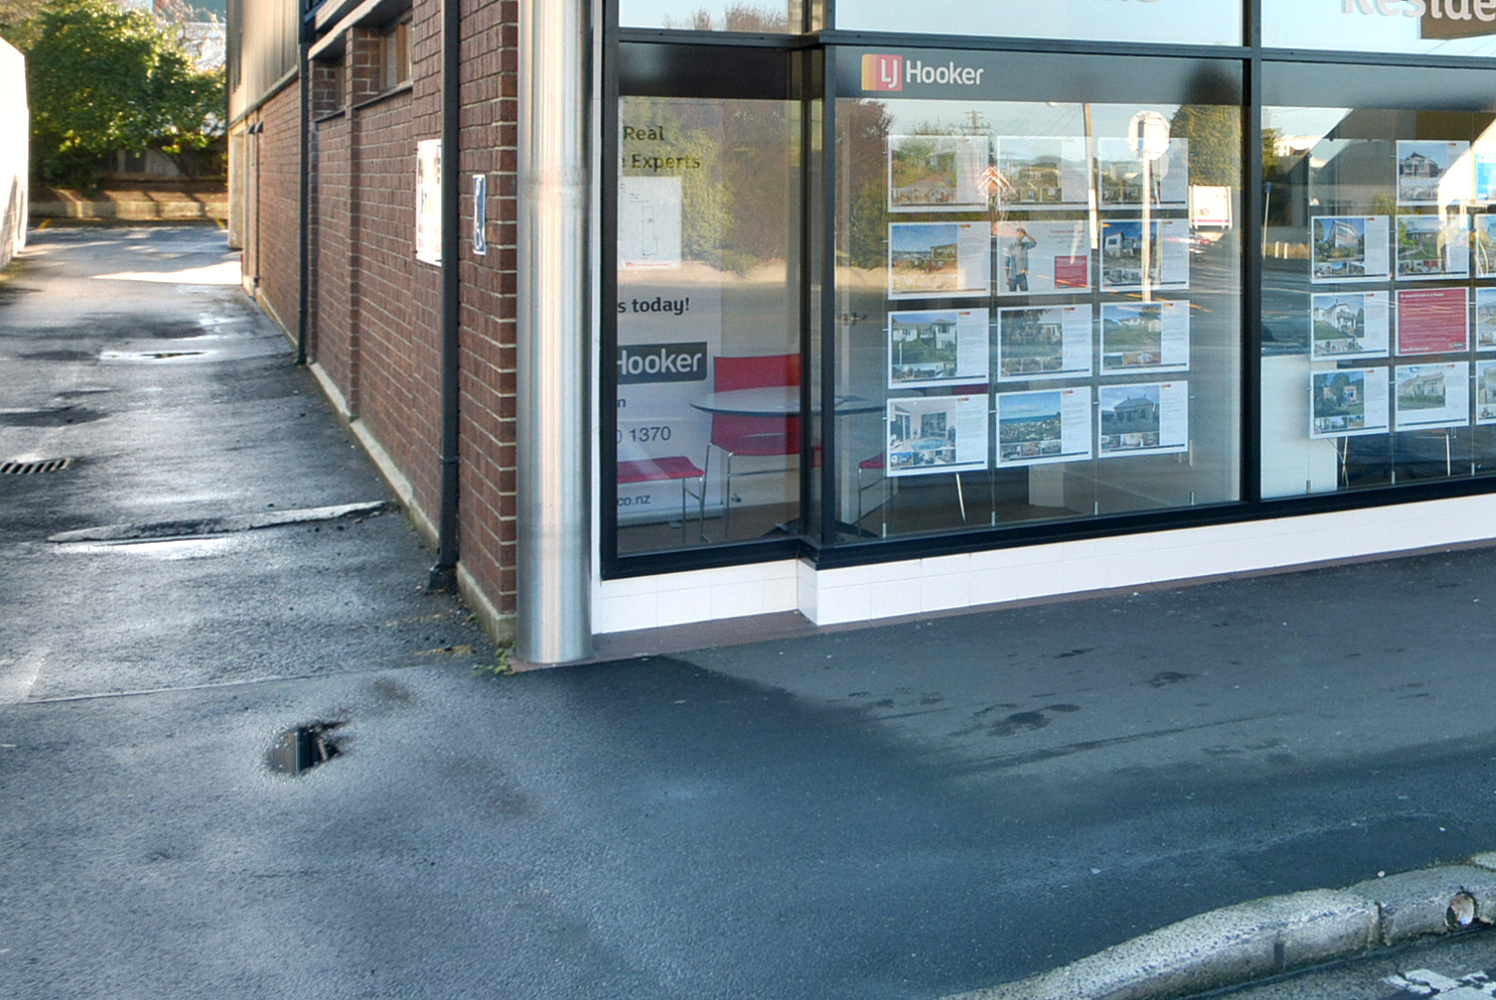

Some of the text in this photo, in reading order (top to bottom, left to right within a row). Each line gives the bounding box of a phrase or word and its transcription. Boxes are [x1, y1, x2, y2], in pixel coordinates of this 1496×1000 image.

[881, 58, 985, 89] LJ Hooker
[623, 125, 665, 142] Real
[631, 153, 701, 172] Experts
[632, 297, 690, 316] today!
[629, 426, 672, 443] 1370
